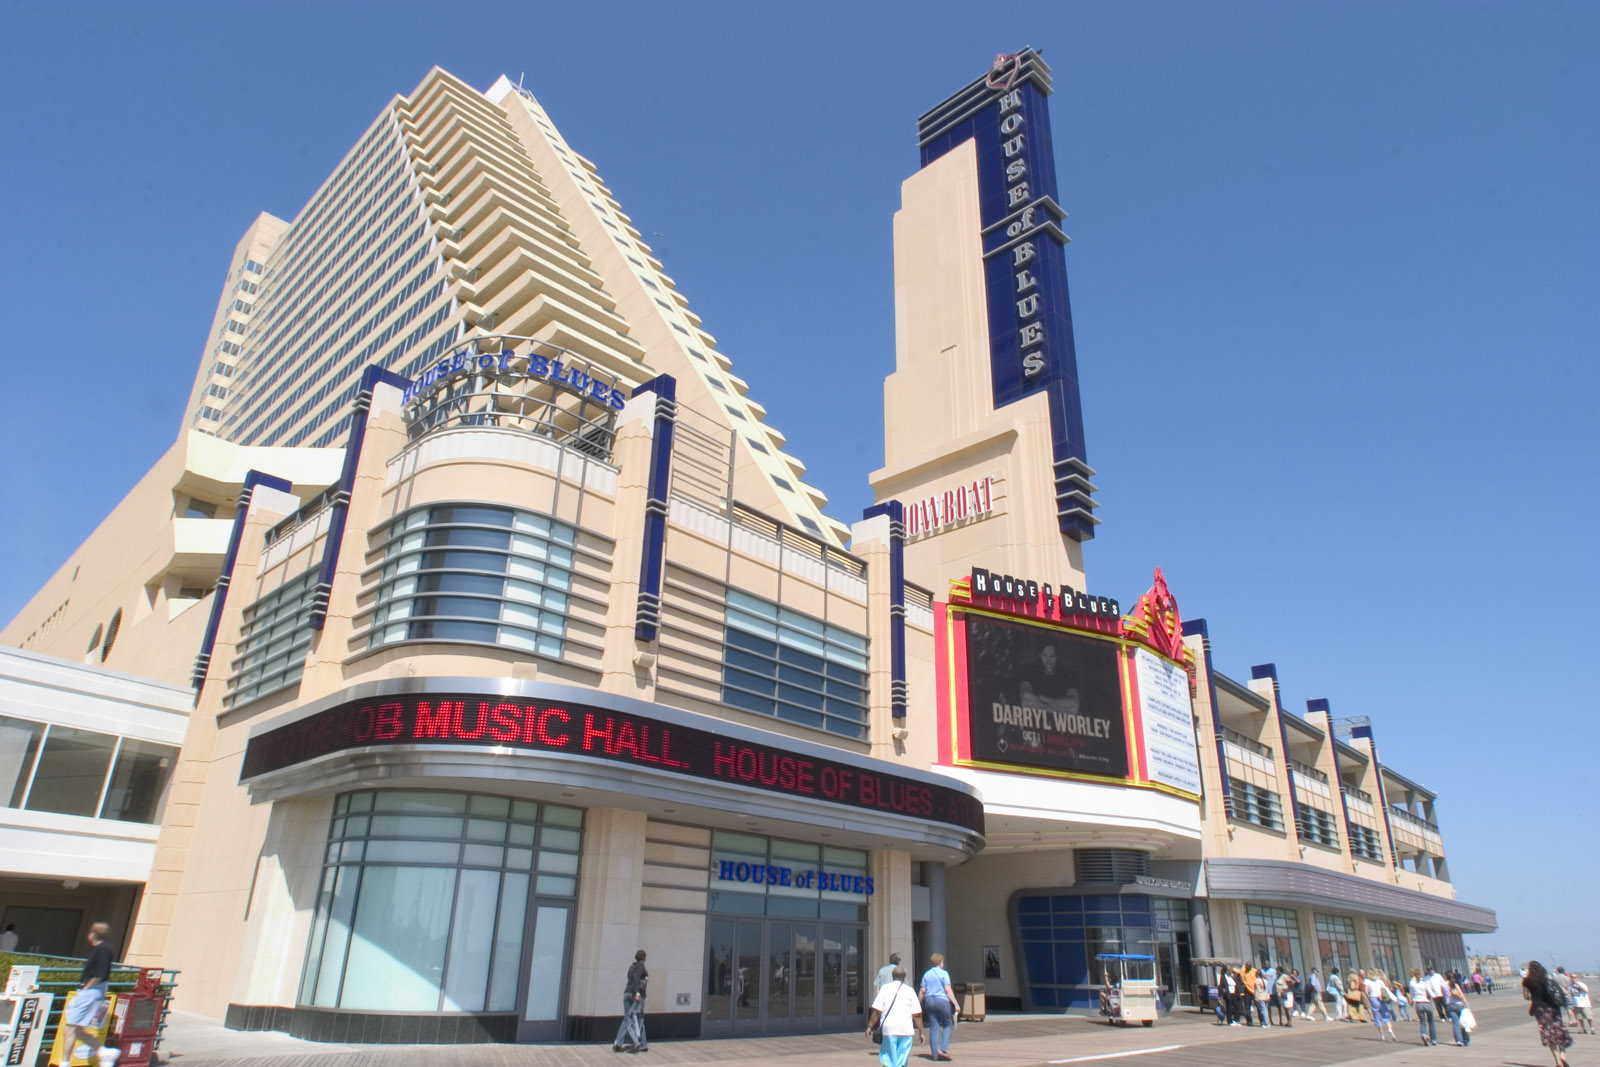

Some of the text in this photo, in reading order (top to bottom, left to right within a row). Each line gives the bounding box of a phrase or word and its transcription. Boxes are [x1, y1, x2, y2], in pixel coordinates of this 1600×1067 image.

[999, 88, 1045, 377] HOUSE of BLUES
[400, 350, 626, 411] HOUSE of BLUES
[976, 574, 1036, 598] HOUSE
[1064, 592, 1118, 615] BLUES
[412, 700, 571, 747] MUSIC
[992, 702, 1111, 739] DARRYL WORLEY
[713, 741, 815, 794] HOUSE
[821, 766, 853, 799] OF
[859, 774, 933, 816] BLUES
[719, 859, 875, 896] HOUSE of BLUES
[8, 999, 38, 1064] The Inquirer
